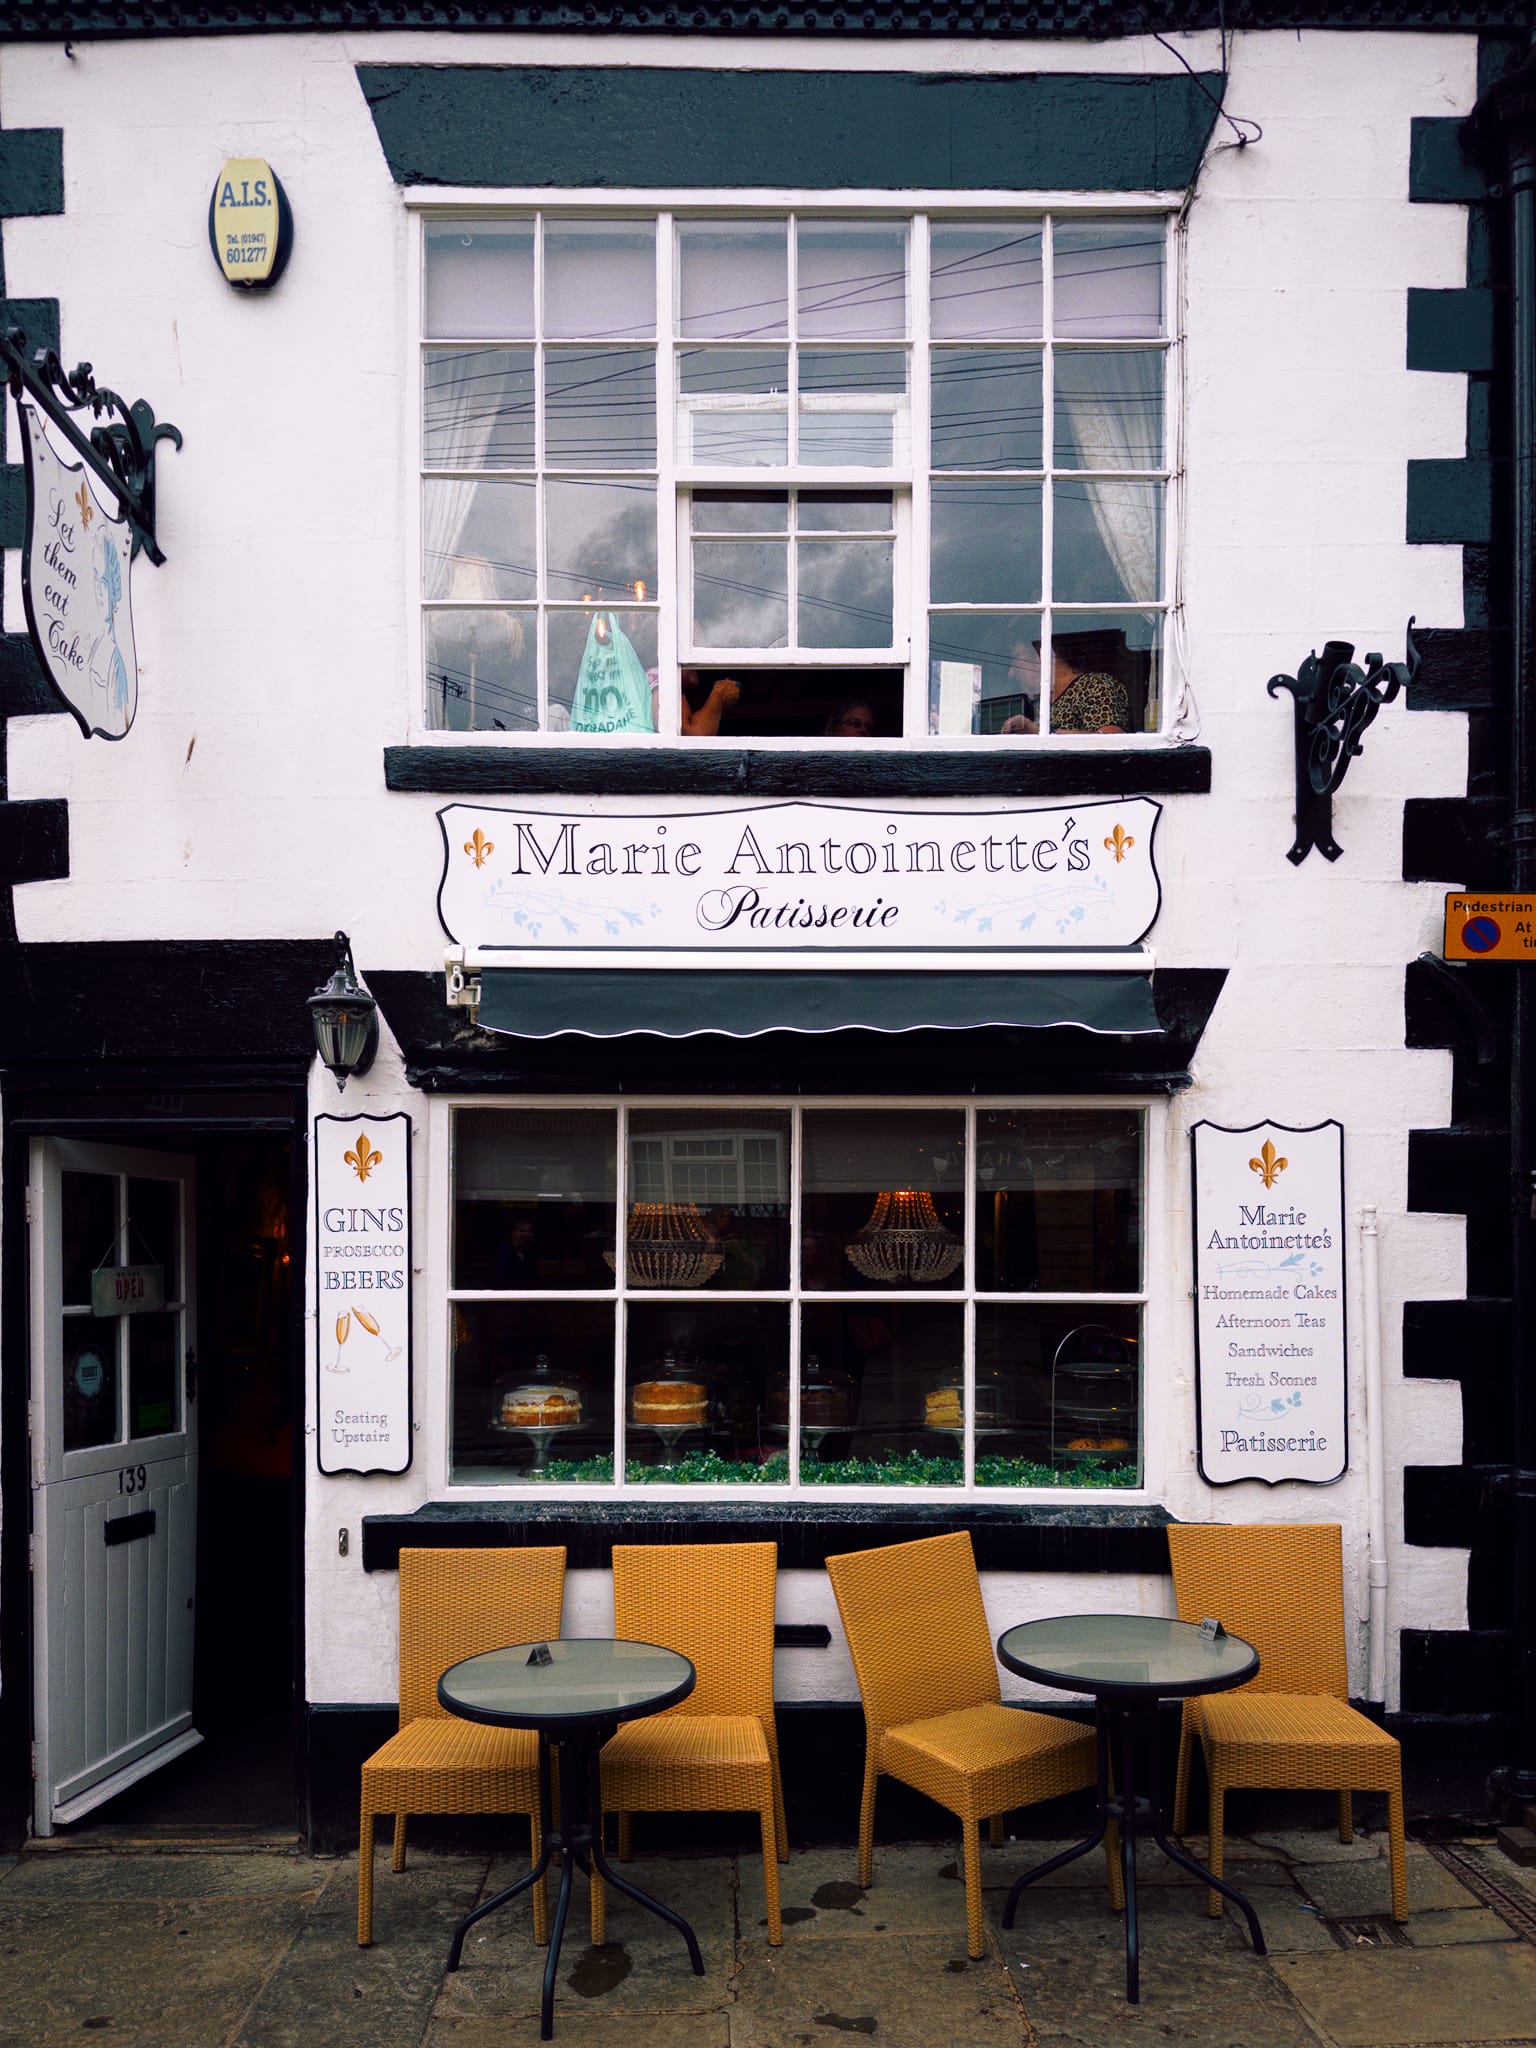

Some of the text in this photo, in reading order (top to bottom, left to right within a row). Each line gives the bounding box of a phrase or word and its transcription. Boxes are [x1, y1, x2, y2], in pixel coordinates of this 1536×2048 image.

[220, 181, 272, 207] A.I.S.
[227, 247, 267, 263] 601277
[48, 487, 76, 553] Let
[44, 541, 77, 590] them
[44, 584, 69, 617] eat
[43, 613, 85, 672] Cake
[511, 817, 1091, 876] Marie Antoinette's
[696, 885, 900, 931] Patisserie
[1453, 901, 1533, 912] Pedestrian
[1515, 922, 1532, 933] At
[323, 1207, 404, 1233] GINS
[1239, 1205, 1307, 1226] Marie
[1206, 1227, 1332, 1250] Antoinette's
[323, 1245, 404, 1258] PROSECCO
[115, 1277, 145, 1300] OPEN
[324, 1269, 404, 1290] BEERS
[1203, 1284, 1338, 1300] Homemade Cakes
[1215, 1312, 1327, 1329] Afternoon Teas
[1228, 1342, 1314, 1358] Sandwiches
[1225, 1371, 1318, 1388] Fresh Scones
[334, 1409, 388, 1429] Seating
[331, 1428, 390, 1448] Upstairs
[1220, 1430, 1327, 1453] Patisserie
[118, 1465, 147, 1495] 139
